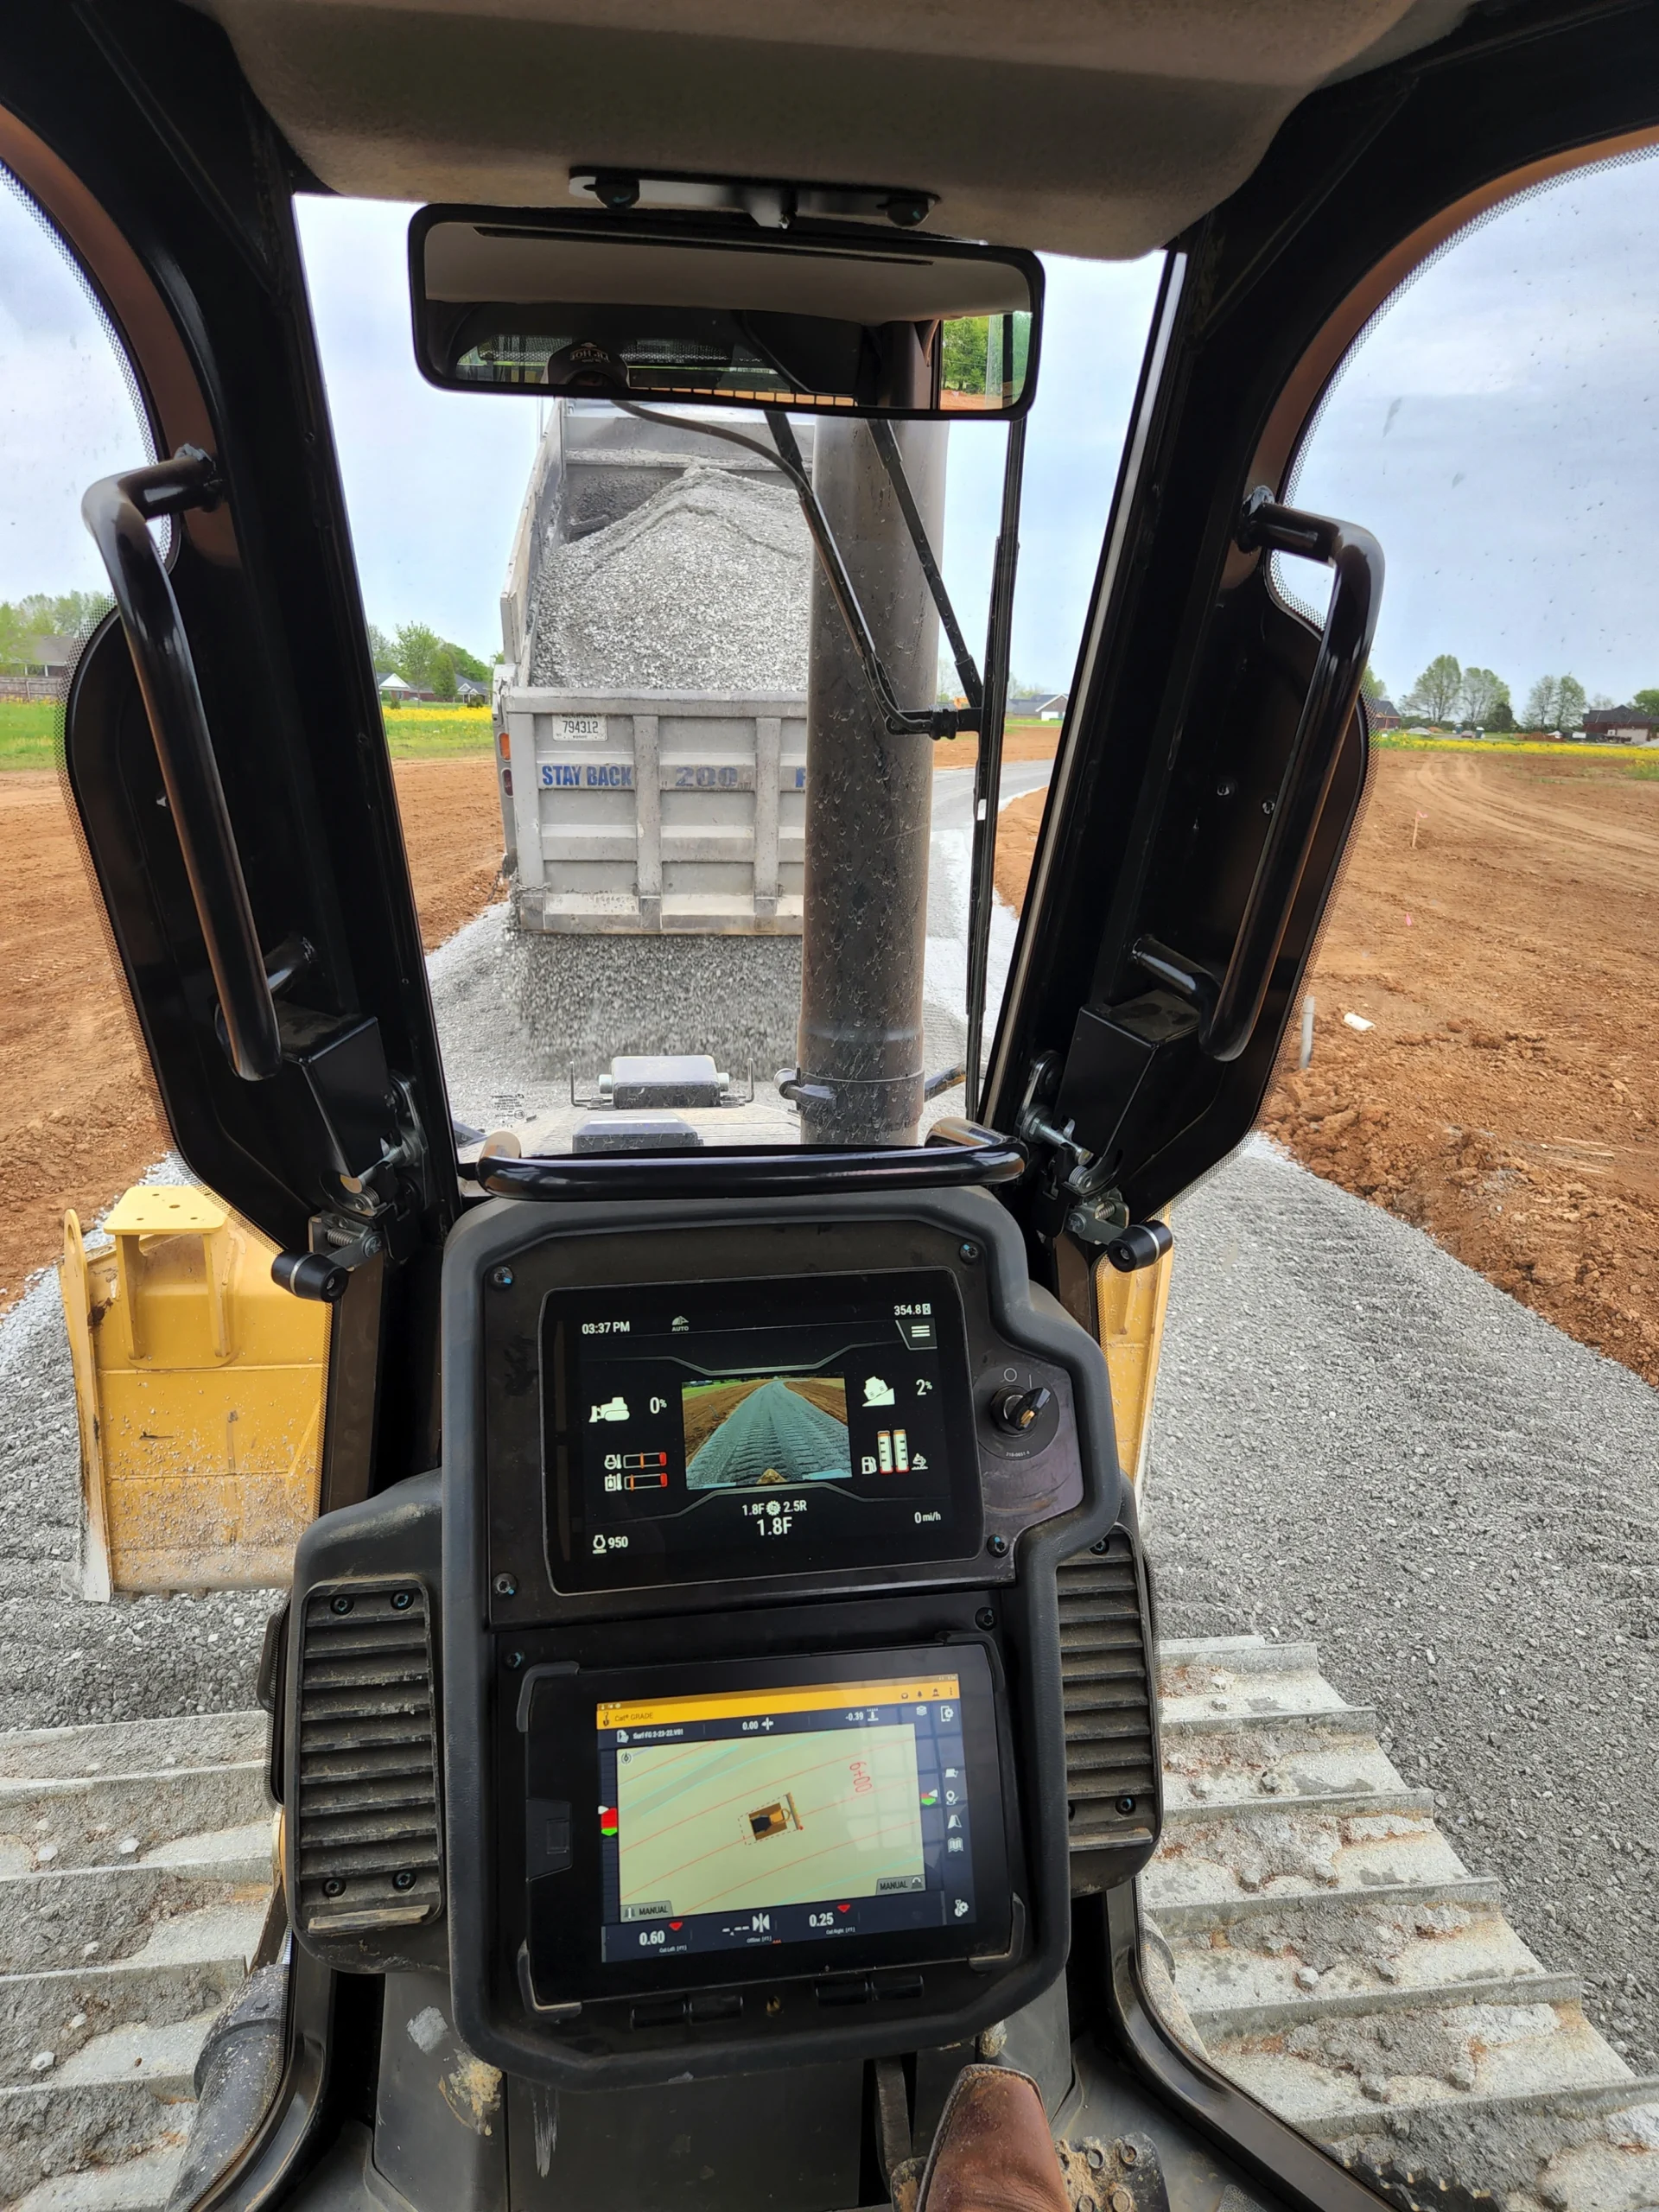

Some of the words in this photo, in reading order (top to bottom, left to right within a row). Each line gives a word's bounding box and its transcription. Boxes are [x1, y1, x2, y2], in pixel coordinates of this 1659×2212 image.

[562, 721, 599, 734] 794312
[541, 765, 582, 785] STAY
[586, 766, 632, 786] BACK
[675, 766, 738, 787] 200
[893, 1304, 922, 1316] 354.8
[582, 1322, 611, 1335] 03:37
[613, 1320, 631, 1332] PM
[741, 1503, 766, 1516] 1.8F
[783, 1499, 807, 1513] 2.5R
[914, 1511, 922, 1524] 0
[922, 1510, 942, 1522] mi/h
[756, 1516, 792, 1536] 1.8F
[607, 1535, 629, 1549] 950
[630, 1712, 654, 1721] GRADE
[845, 1711, 864, 1722] -0.39
[741, 1720, 759, 1731] 0.00
[880, 1879, 908, 1891] MANUAL
[639, 1905, 668, 1916] MANUAL
[809, 1912, 835, 1927] 0.25
[639, 1929, 665, 1946] 0.60
